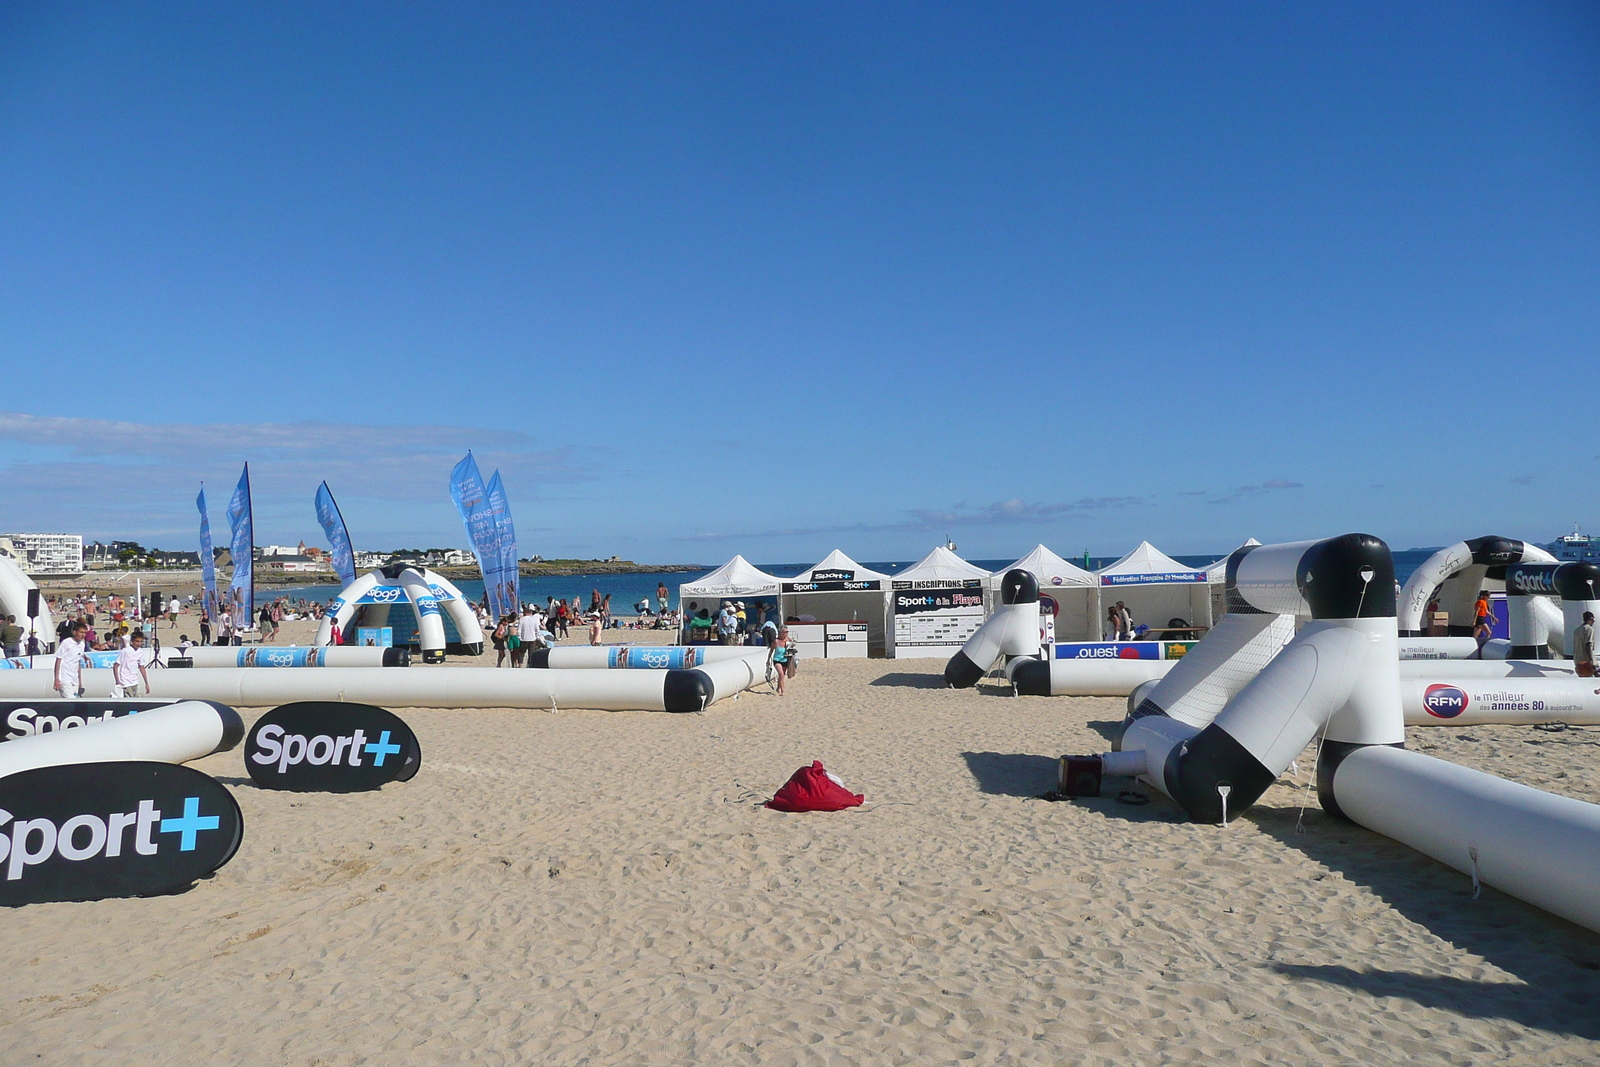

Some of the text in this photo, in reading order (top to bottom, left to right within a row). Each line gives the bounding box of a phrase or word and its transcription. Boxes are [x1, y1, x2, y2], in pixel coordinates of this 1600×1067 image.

[814, 572, 851, 580] Sport+
[1514, 570, 1552, 593] Sport+
[793, 583, 819, 591] Sport+
[843, 582, 870, 590] Sport+
[914, 580, 962, 589] INSCRIPTIONS
[898, 596, 934, 607] Sport+
[953, 593, 982, 606] Playa
[1079, 645, 1119, 658] ouest
[1428, 697, 1462, 707] RFM
[1483, 691, 1525, 702] meilleur
[1491, 700, 1530, 711] années
[1532, 701, 1544, 711] 80
[251, 723, 401, 774] Sport+
[0, 797, 220, 881] port+
